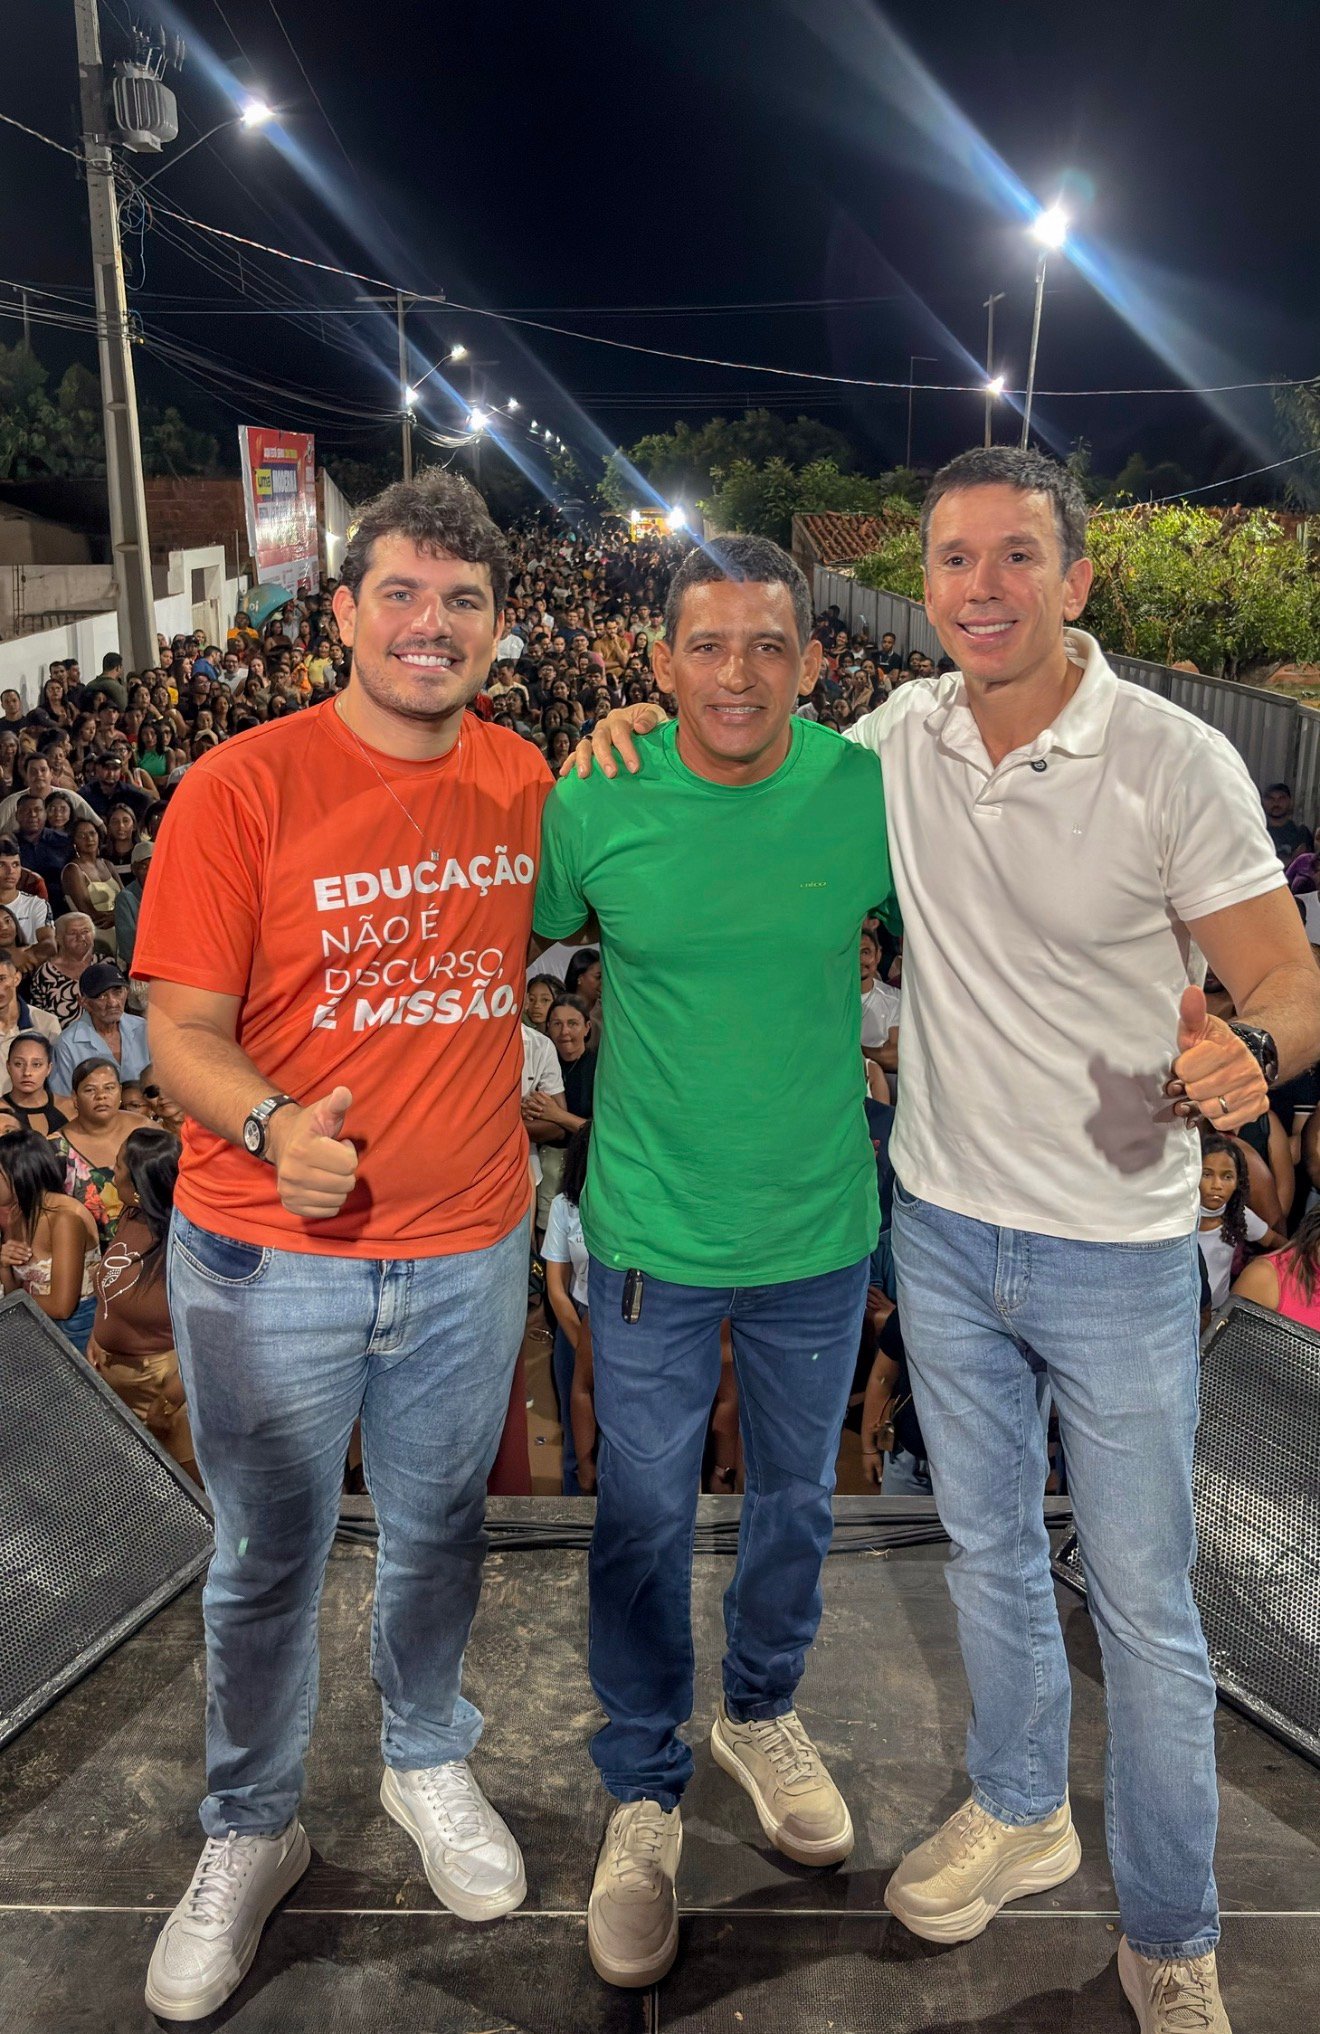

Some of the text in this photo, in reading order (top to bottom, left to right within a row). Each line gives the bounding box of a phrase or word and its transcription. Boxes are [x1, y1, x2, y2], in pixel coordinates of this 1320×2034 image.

[313, 845, 535, 912] EDUCAÇÃO
[321, 903, 440, 957] NÃO É
[325, 948, 504, 995] DISCURSO,
[311, 979, 518, 1032] É MISSÃO.
